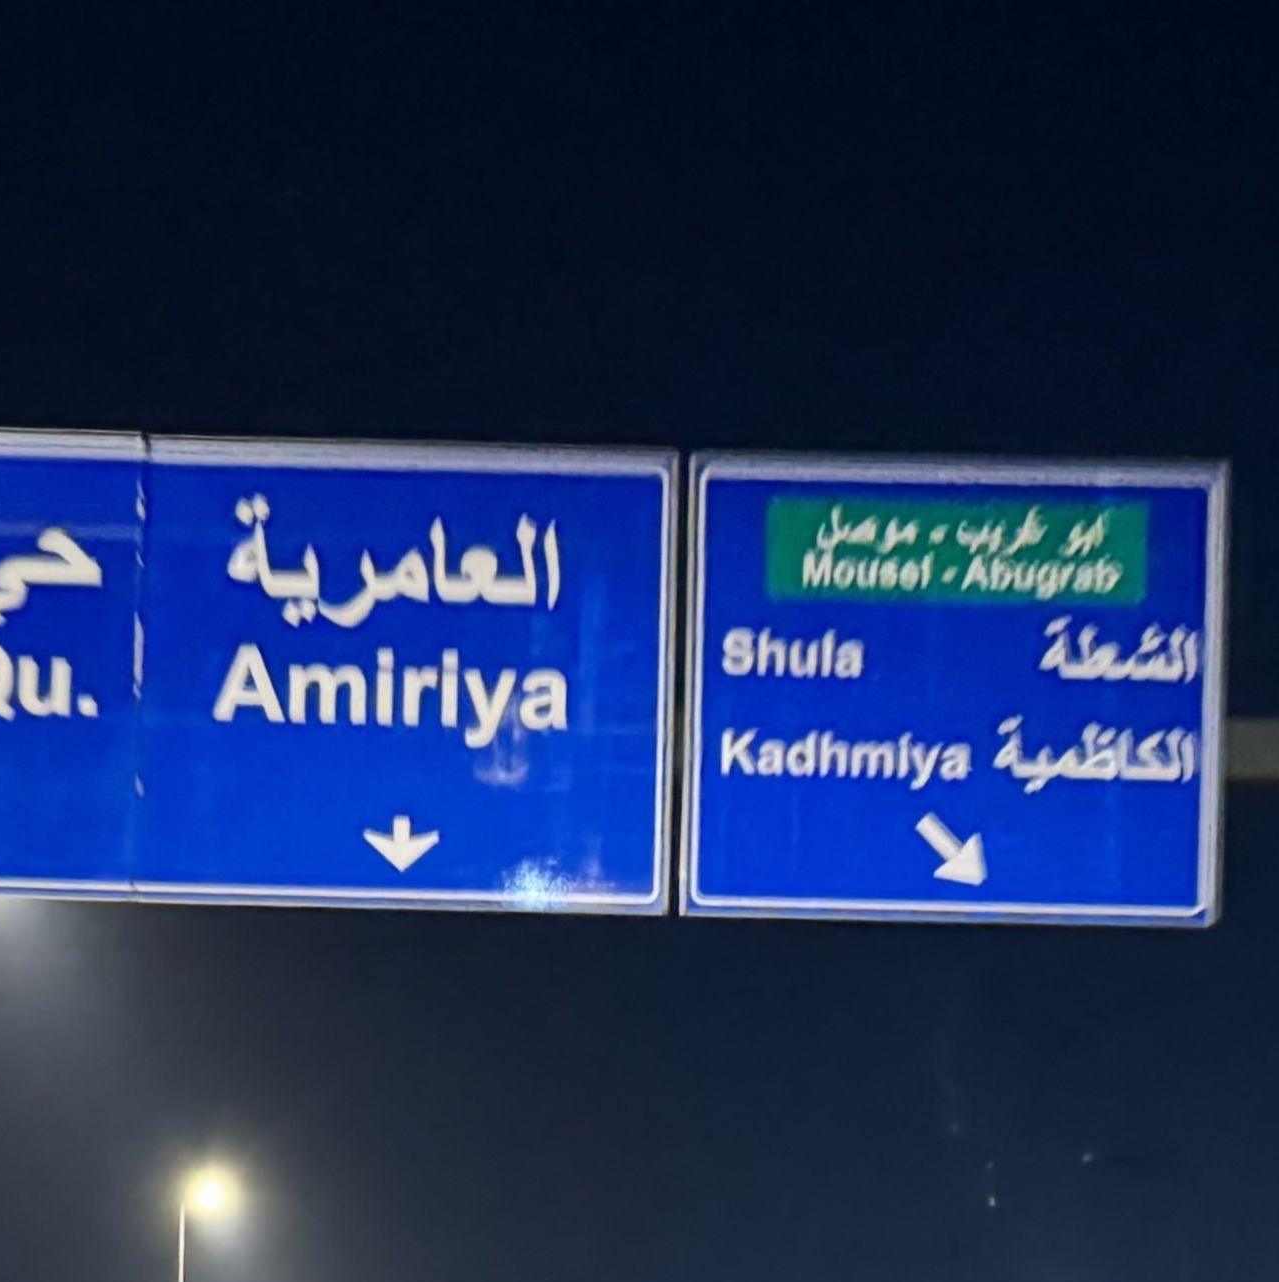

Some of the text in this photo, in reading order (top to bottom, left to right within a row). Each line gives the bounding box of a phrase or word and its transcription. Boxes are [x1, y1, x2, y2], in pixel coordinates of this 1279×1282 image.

[226, 494, 561, 628] العامرية
[961, 555, 1122, 600] Abugrab
[721, 627, 864, 679] Shula
[212, 644, 568, 749] Amiriya
[720, 727, 971, 790] Kadhmiya
[993, 715, 1197, 794] الكاظمية
